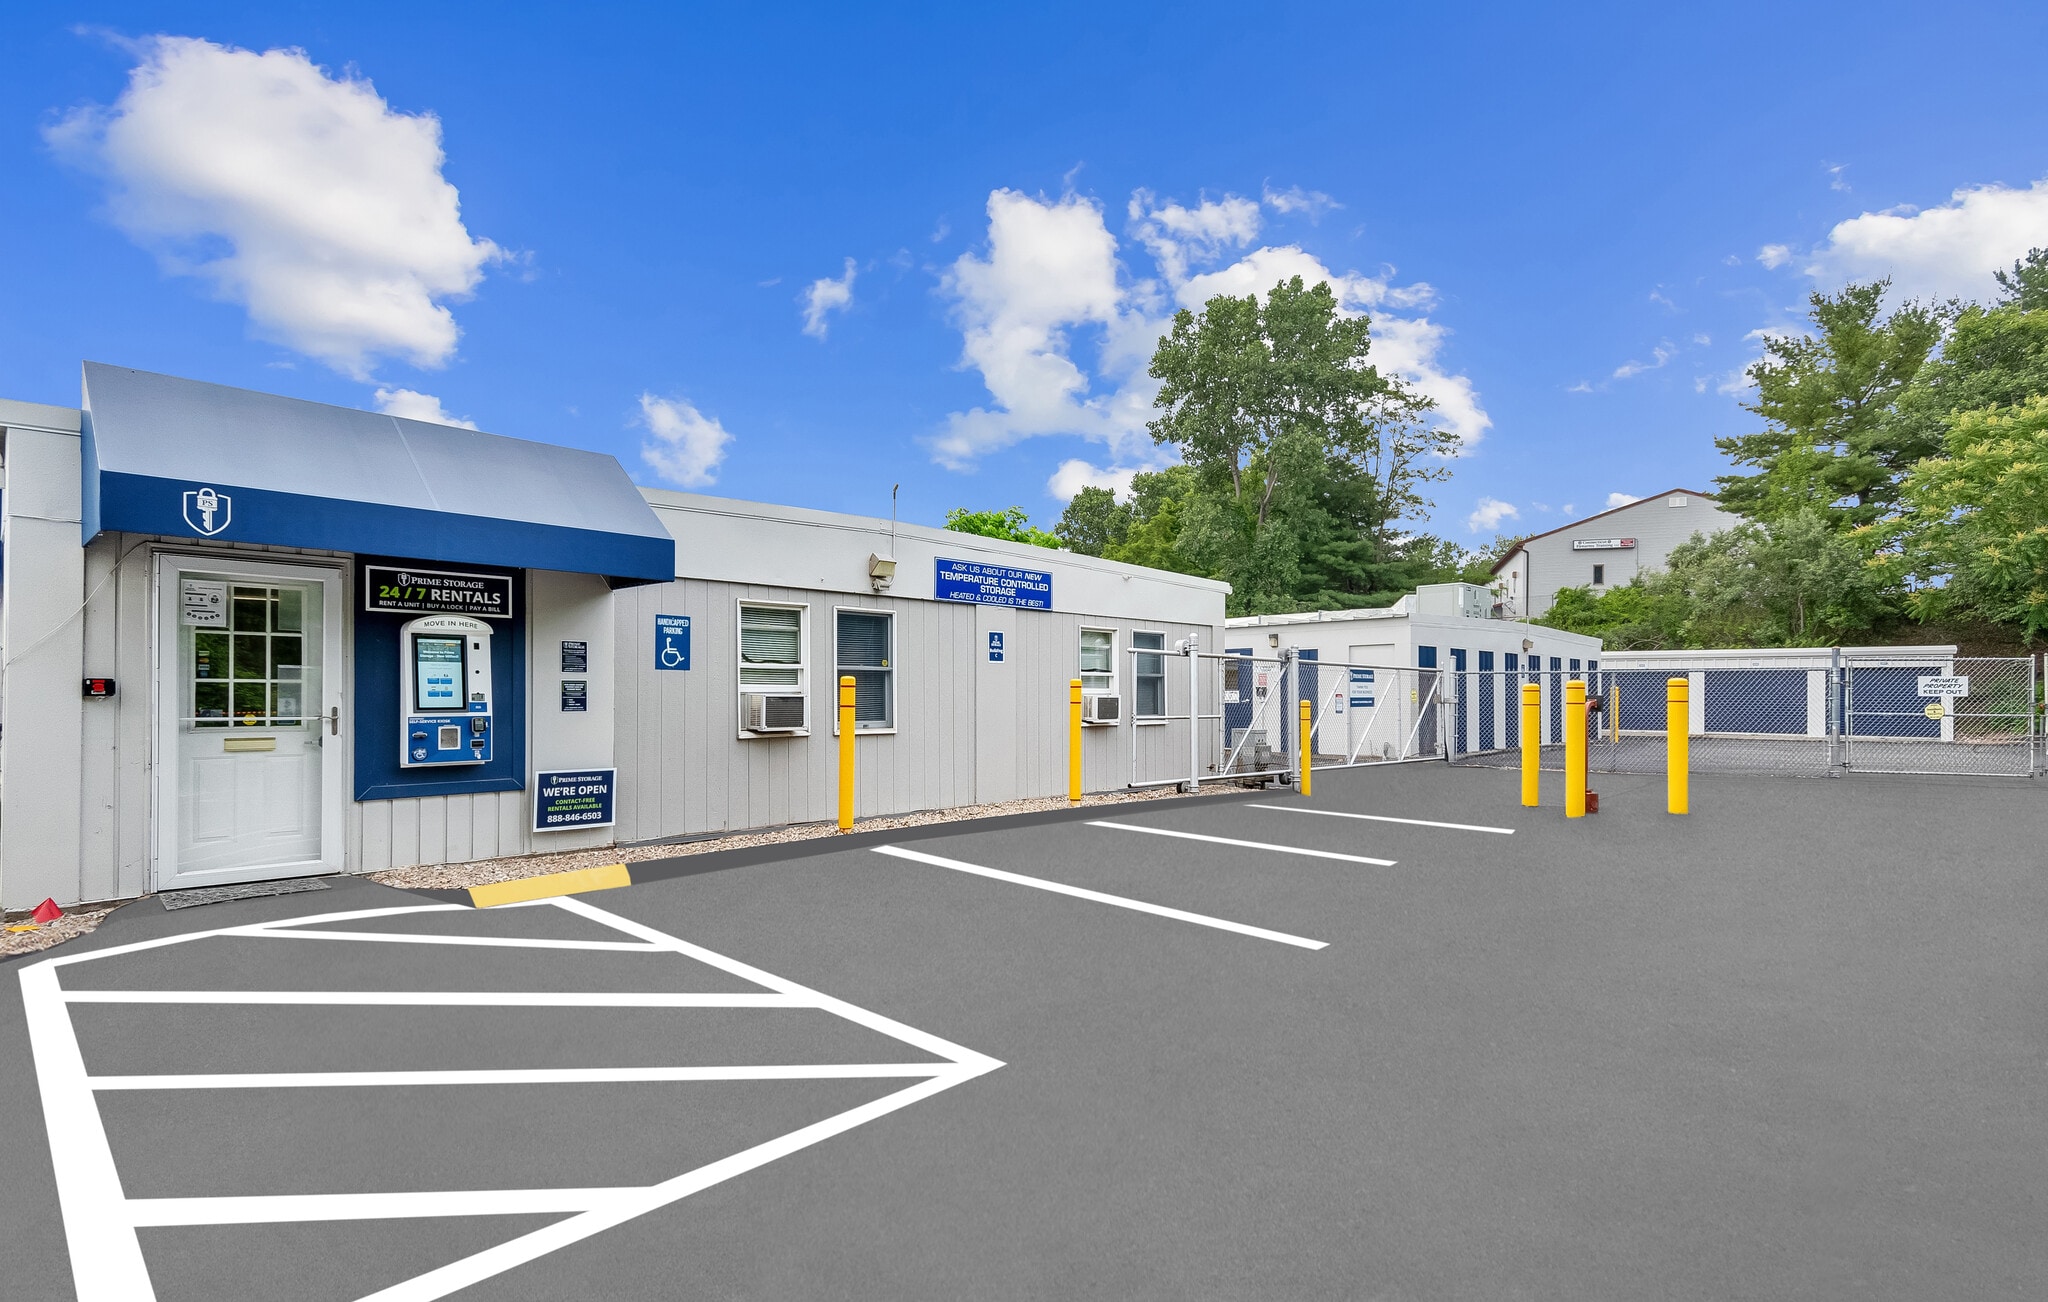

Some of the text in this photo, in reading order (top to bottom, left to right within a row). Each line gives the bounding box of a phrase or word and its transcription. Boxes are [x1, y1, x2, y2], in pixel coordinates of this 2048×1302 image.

[952, 563, 967, 572] ASK
[982, 567, 1006, 577] ABOUT
[1008, 570, 1022, 578] OUR
[1024, 573, 1042, 581] NEW
[411, 576, 484, 589] PRIME STORAGE
[940, 571, 1048, 592] TEMPERATURE CONTROLLED
[431, 589, 501, 604] RENTALS
[980, 586, 1016, 597] STORAGE
[950, 591, 974, 600] HEATED
[983, 594, 1007, 604] COOLED
[459, 621, 478, 629] HERE
[657, 618, 689, 626] HANDICAPPED
[663, 627, 683, 635] PARKING
[543, 785, 607, 797] WE'RE OPEN
[555, 797, 595, 805] CONTACT-FREE
[547, 812, 602, 823] 888-846-6503
